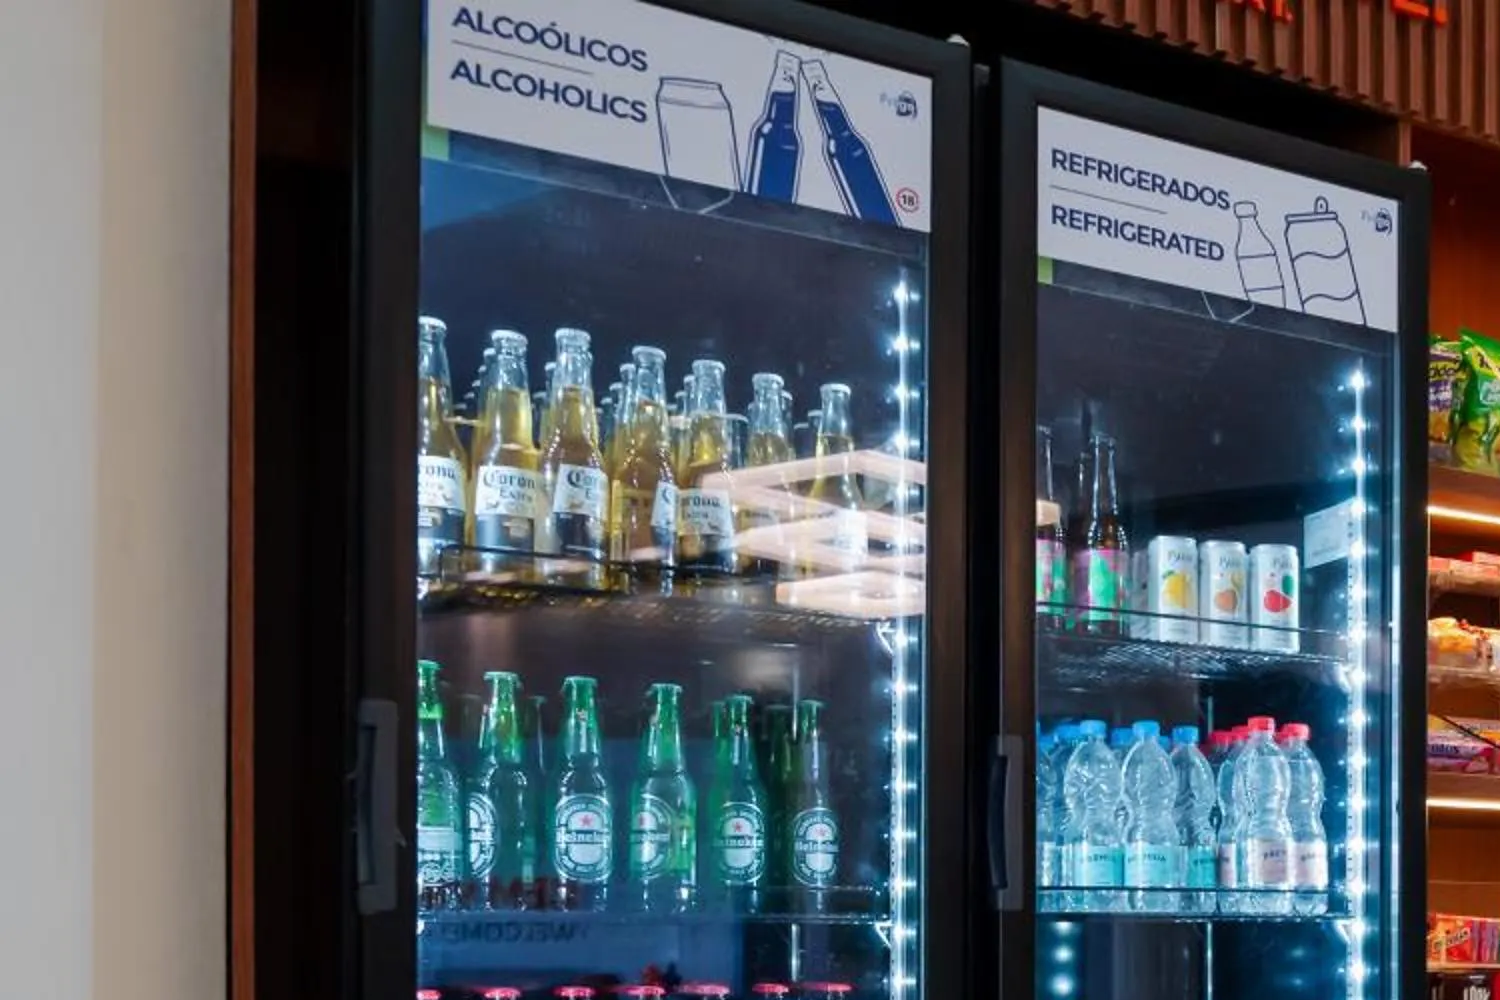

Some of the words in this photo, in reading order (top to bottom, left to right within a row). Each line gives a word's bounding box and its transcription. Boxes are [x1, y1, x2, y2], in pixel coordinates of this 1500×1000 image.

[451, 5, 648, 72] ALCOÓLICOS
[450, 60, 648, 123] ALCOHOLICS
[1051, 148, 1230, 210] REFRIGERADOS
[1051, 204, 1225, 262] REFRIGERATED
